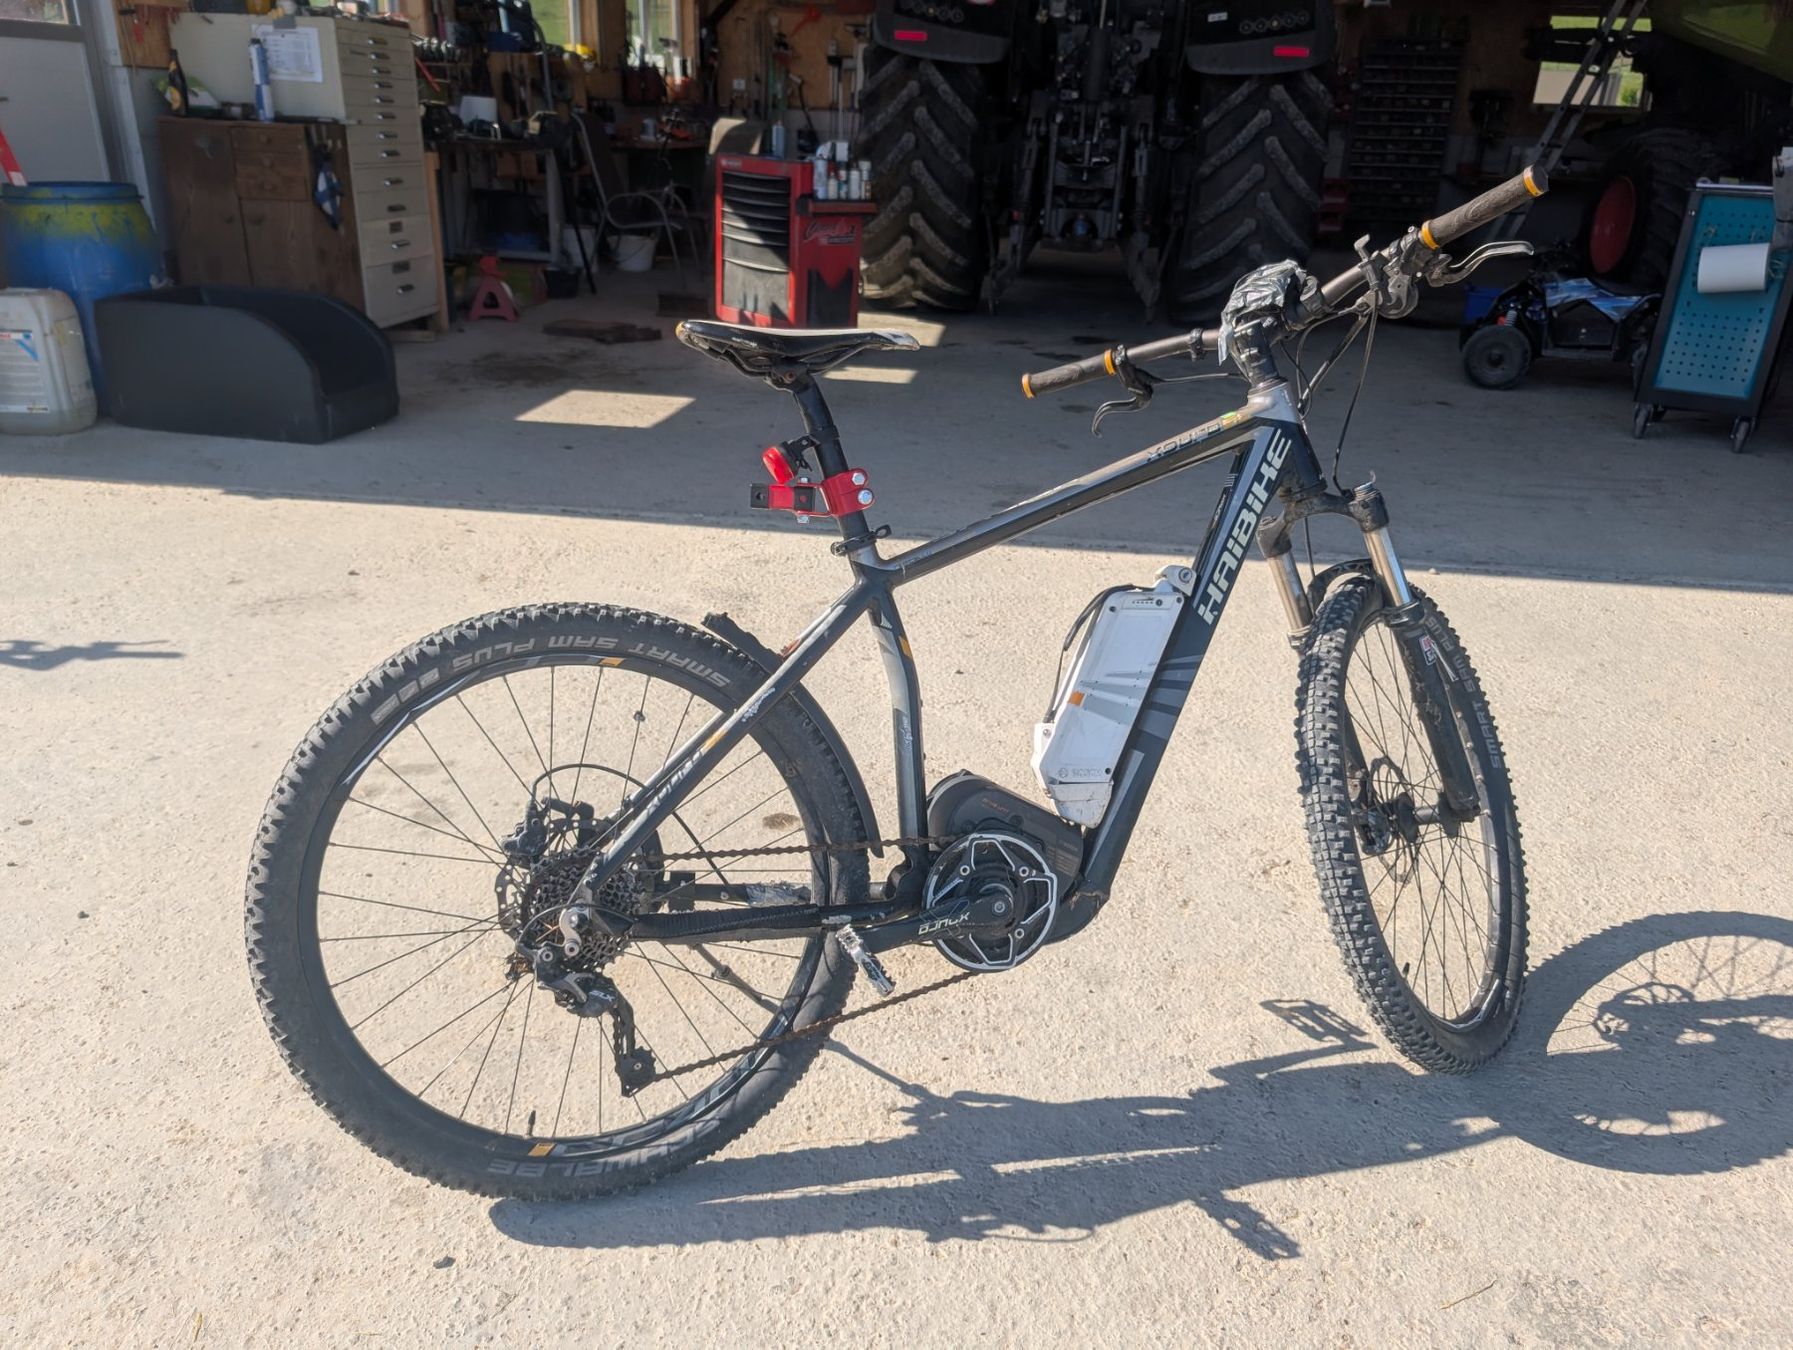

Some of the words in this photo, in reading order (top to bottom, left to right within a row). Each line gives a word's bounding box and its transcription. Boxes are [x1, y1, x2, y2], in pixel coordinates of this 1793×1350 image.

[547, 634, 620, 651] SAM
[1426, 616, 1454, 651] PLUS
[452, 637, 536, 673] PLUS
[627, 641, 733, 688] SMART
[1452, 655, 1475, 693] SAM
[1472, 700, 1502, 770] SMART
